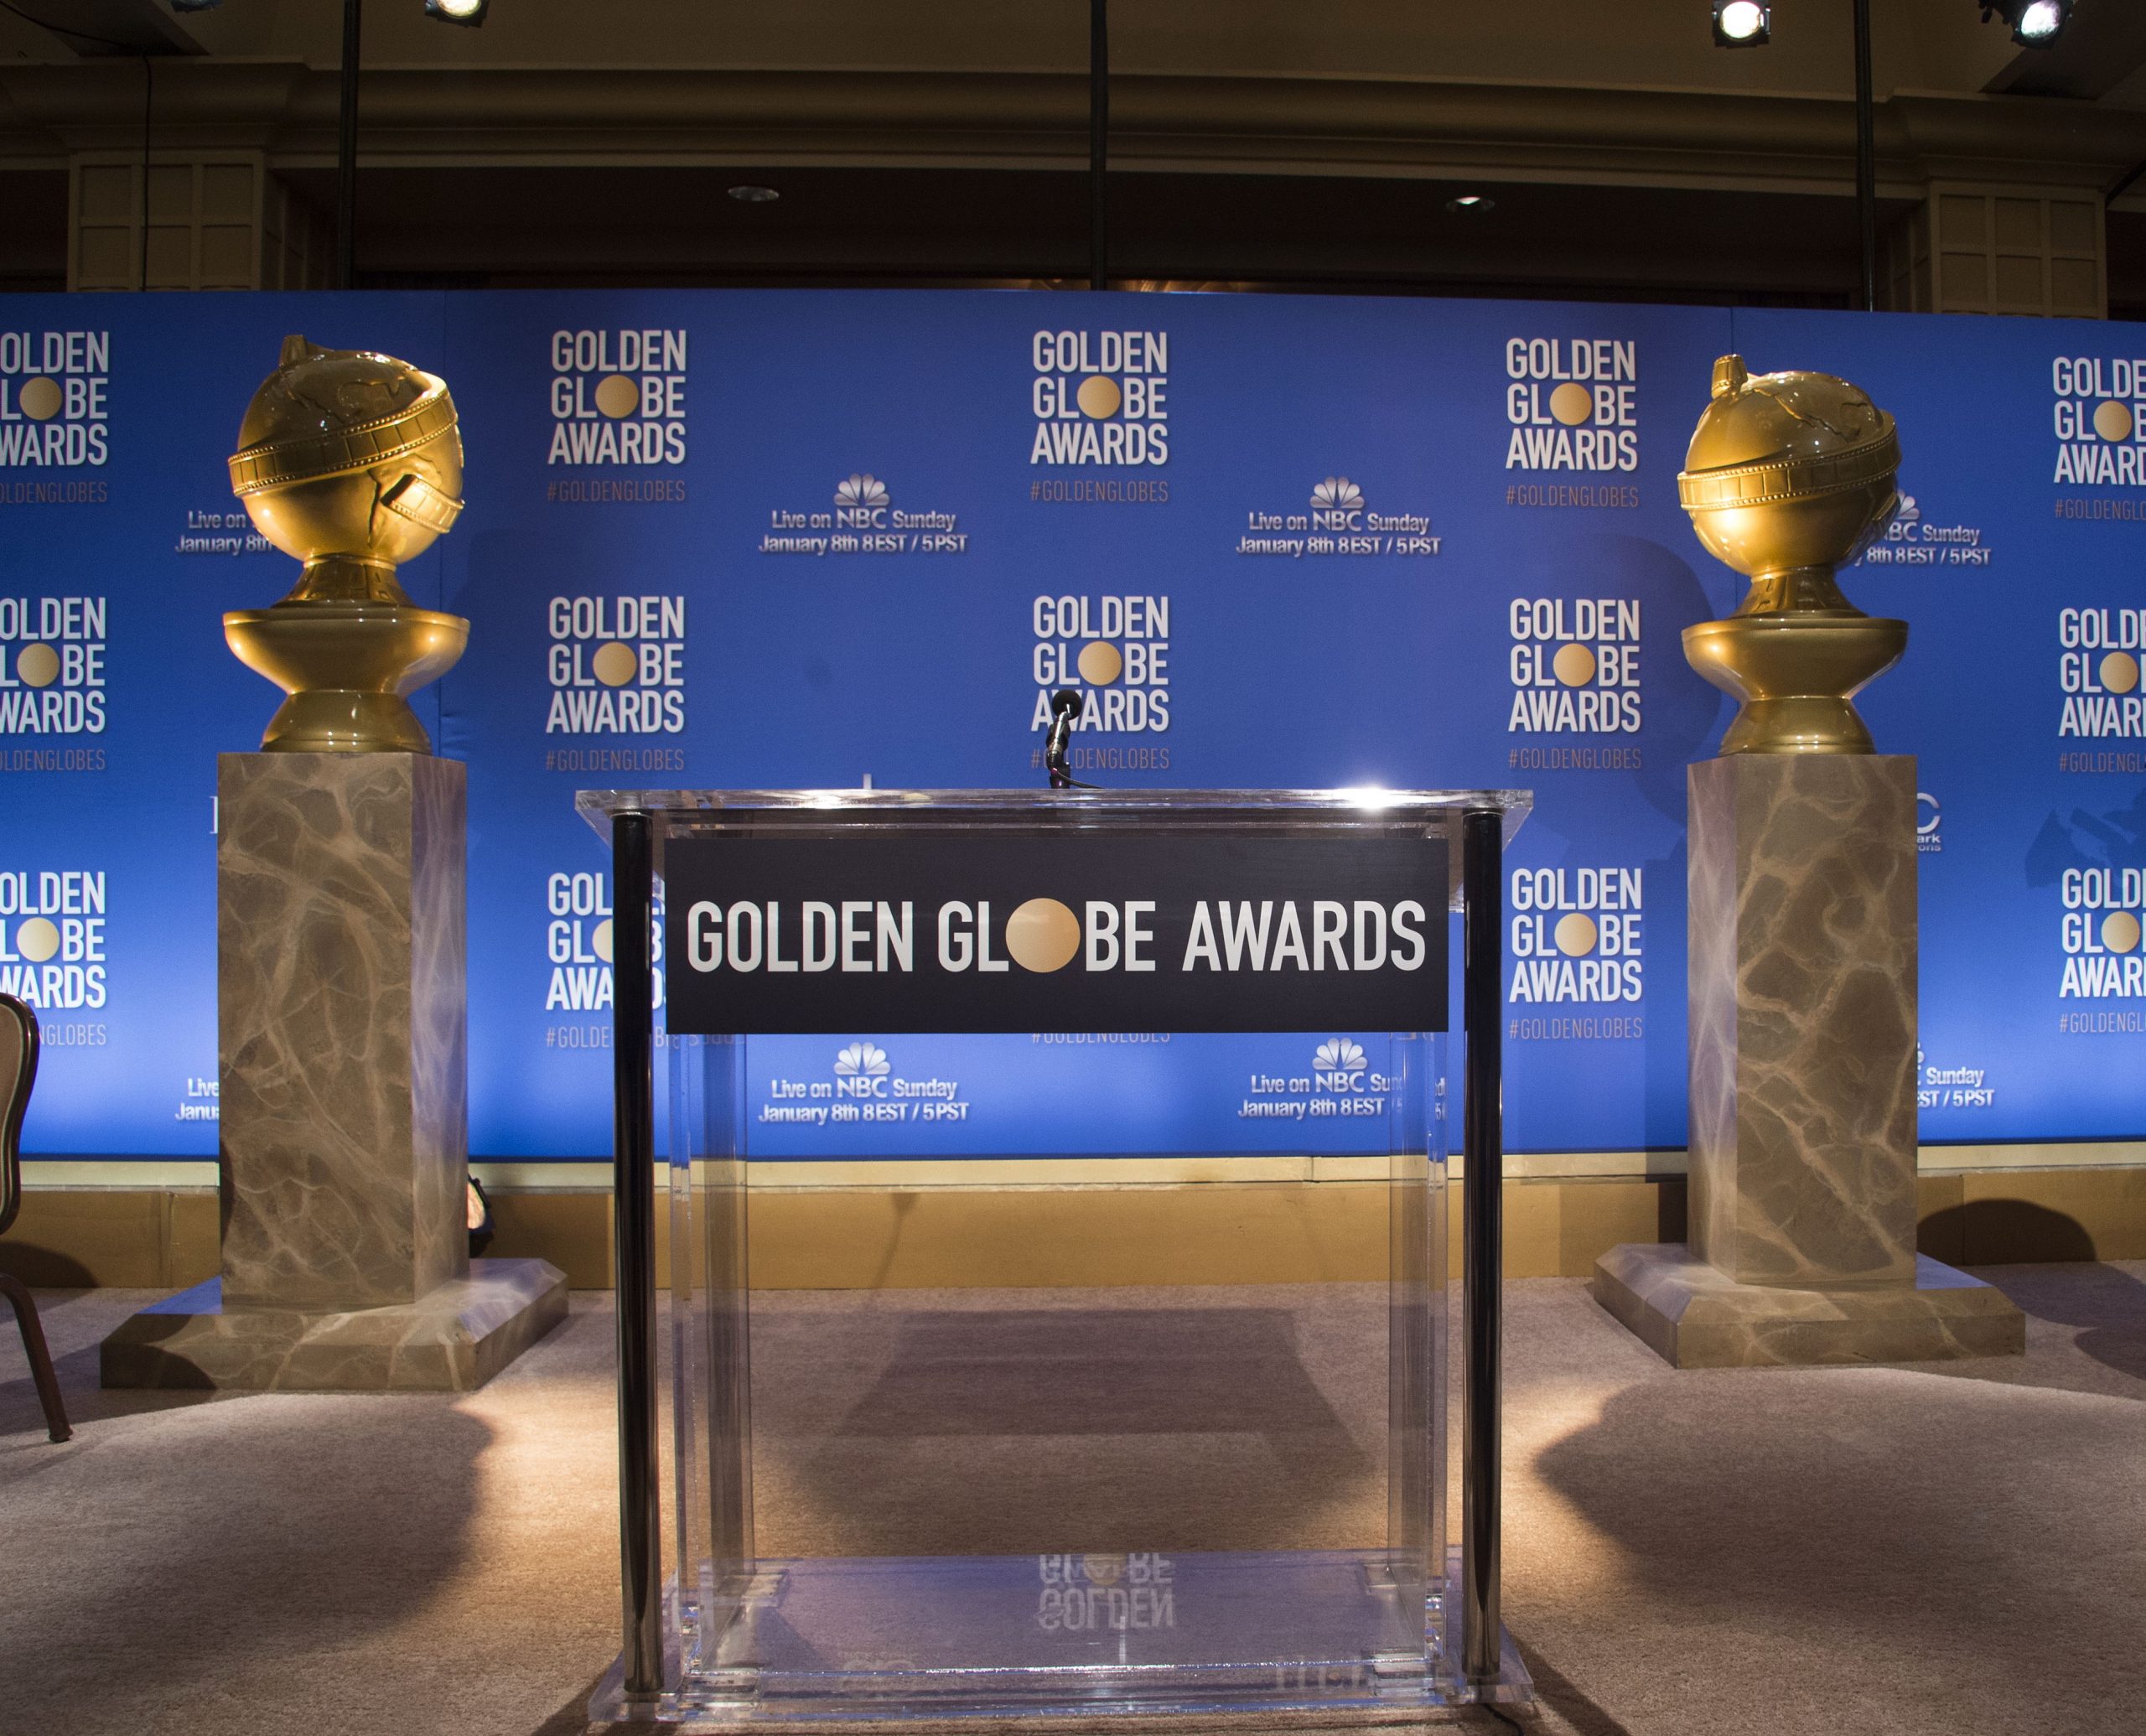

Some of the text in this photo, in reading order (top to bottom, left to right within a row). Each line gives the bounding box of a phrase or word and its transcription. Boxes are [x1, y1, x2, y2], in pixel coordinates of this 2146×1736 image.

[0, 331, 109, 374] OLDEN
[552, 329, 686, 372] GOLDEN
[1033, 330, 1167, 373] GOLDEN
[1506, 338, 1635, 381] GOLDEN
[1, 376, 108, 420] LOBE
[2053, 356, 2146, 399] GOLDE
[2055, 400, 2146, 442] GLOB
[0, 422, 108, 466] WARDS
[547, 422, 686, 464] AWARDS
[1030, 422, 1168, 465] AWARDS
[1506, 428, 1637, 471] AWARDS
[2054, 444, 2146, 485] AWAR
[0, 481, 107, 503] LDENGLOBES
[547, 479, 685, 501] #GOLDENGLOBES
[1030, 480, 1168, 501] #GOLDENGLOBES
[1506, 485, 1638, 507] #GOLDENGLOBES
[2055, 498, 2146, 520] #GOLDENGLO
[189, 510, 246, 529] Live on
[771, 508, 956, 532] Live on NBC Sunday
[1248, 510, 1429, 535] Live on NBC Sunday
[1884, 521, 1980, 547] BC Sunday
[174, 535, 242, 556] January
[758, 534, 827, 556] January
[831, 534, 858, 552] 8th
[1236, 536, 1304, 557] January
[1307, 536, 1334, 554] 8th
[1866, 546, 1891, 563] 8th
[0, 597, 106, 640] OLDEN
[549, 596, 684, 640] GOLDEN
[1034, 595, 1169, 638] GOLDEN
[1510, 598, 1640, 640] GOLDEN
[2059, 608, 2146, 649] GOLD
[0, 643, 106, 687] LOBE
[2060, 651, 2146, 694] GLO
[0, 690, 106, 733] WARDS
[546, 690, 684, 733] AWARDS
[1031, 689, 1169, 732] AARDS
[1508, 690, 1641, 733] AWARDS
[2058, 697, 2146, 737] AWAR
[0, 749, 106, 770] LDENGLOBES
[546, 749, 684, 770] #GOLDENGLOBES
[1031, 748, 1169, 770] #LDENGLOBES
[1508, 749, 1641, 770] #GOLDENGLOBES
[2059, 752, 2146, 773] #GOLDENGL
[0, 872, 106, 915] OLDEN
[1511, 868, 1642, 910] GOLDEN
[2061, 868, 2146, 909] GOLD
[0, 917, 106, 962] LOBE
[687, 900, 914, 972] GOLDEN
[1182, 899, 1428, 972] AWARDS
[2061, 911, 2146, 954] GLO
[1508, 960, 1642, 1003] AWARDS
[2059, 956, 2146, 998] AWAR
[1509, 1018, 1642, 1039] #GOLDENGLOBES
[2059, 1012, 2146, 1033] #GOLDENGL
[771, 1076, 957, 1101] Live on NBC Sunday
[1251, 1075, 1285, 1093] Live
[1288, 1078, 1309, 1093] on
[1314, 1071, 1365, 1092] NBC
[1926, 1066, 1985, 1088] Sunday
[758, 1104, 827, 1126] January
[831, 1103, 859, 1122] 8th
[1238, 1099, 1306, 1120] January
[1309, 1098, 1336, 1117] 8th
